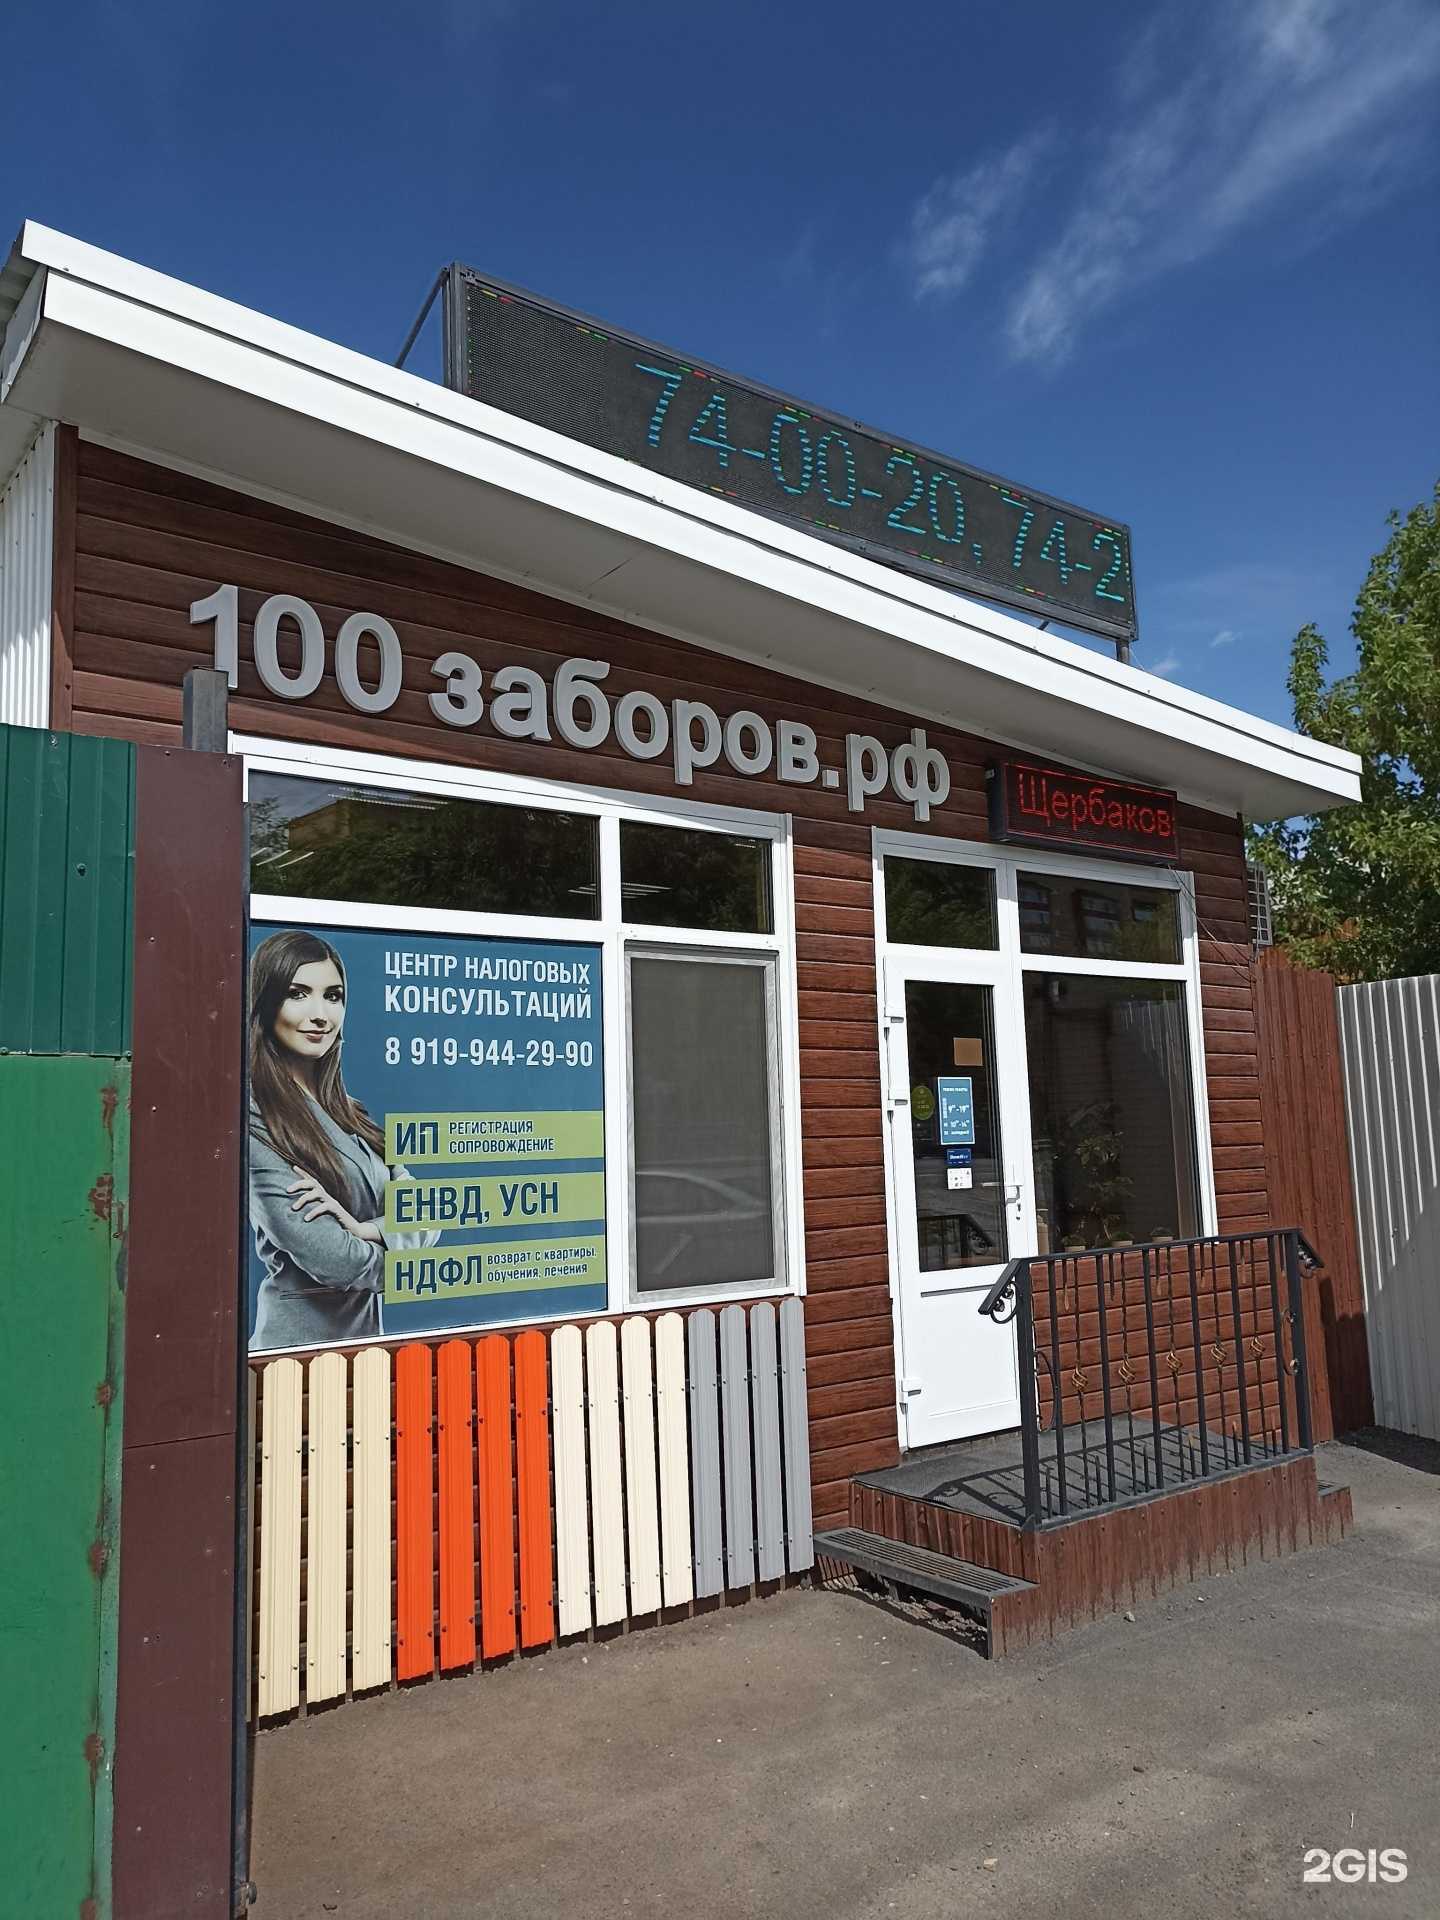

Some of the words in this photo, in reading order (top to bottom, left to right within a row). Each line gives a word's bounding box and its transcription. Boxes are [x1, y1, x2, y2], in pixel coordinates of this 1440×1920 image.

[1001, 496, 1125, 602] 74-2
[189, 583, 403, 714] 100
[427, 651, 951, 823] заборов.рф
[1018, 773, 1176, 838] Щербаков
[384, 950, 458, 979] ЦЕНТР
[464, 956, 591, 985] НАЛОГОВЫХ
[384, 984, 592, 1023] КОНСУЛЬТАЦИЙ
[384, 1036, 401, 1065] 8
[410, 1037, 593, 1067] 919-944-29-90
[395, 1121, 440, 1156] ИП
[448, 1120, 534, 1136] РЕГИСТРАЦИЯ
[448, 1138, 555, 1155] СОПРОВОЖДЕНИЕ
[395, 1184, 491, 1226] ЕНВД,
[498, 1181, 560, 1217] УСН
[395, 1254, 483, 1296] НДФЛ
[486, 1251, 532, 1266] возврат
[534, 1250, 542, 1262] с
[544, 1263, 588, 1278] лечения
